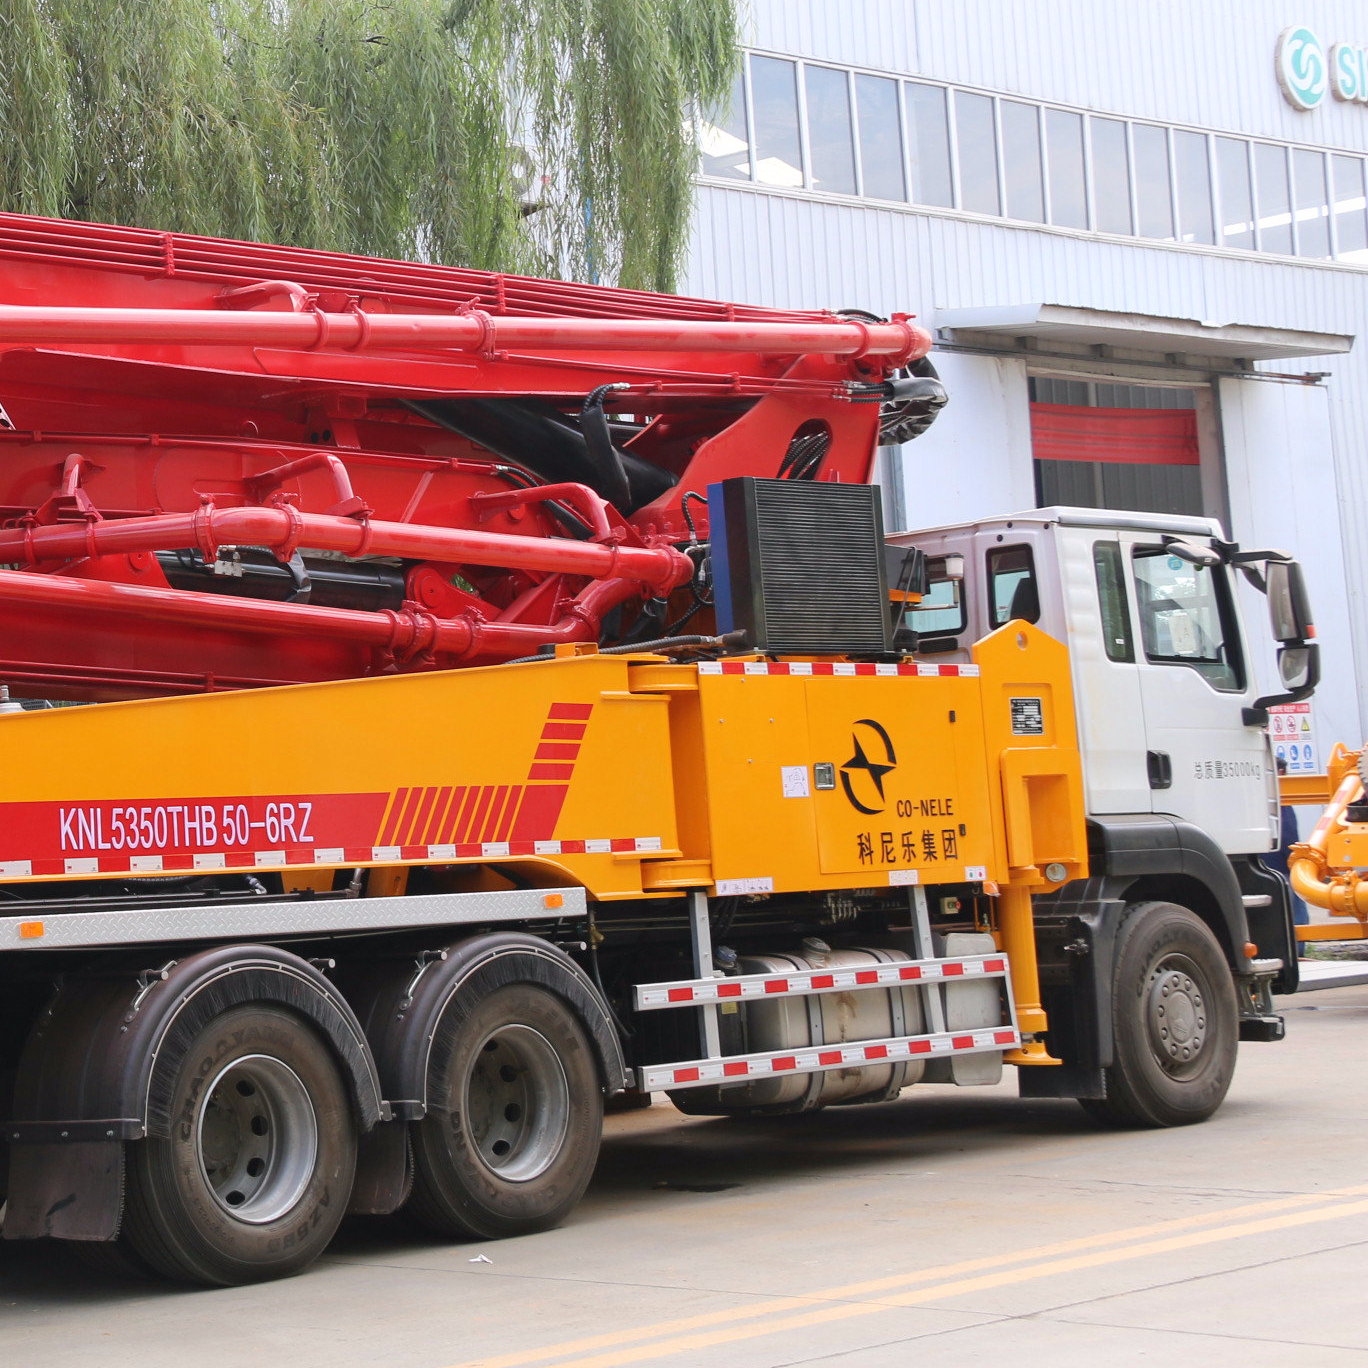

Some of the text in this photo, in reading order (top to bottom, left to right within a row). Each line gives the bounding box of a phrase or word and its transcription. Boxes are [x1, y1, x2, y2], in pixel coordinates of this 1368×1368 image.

[1338, 46, 1368, 98] SI
[59, 802, 314, 850] KNL5350THB 50-6RZ
[896, 798, 954, 818] CO-NELE
[857, 829, 958, 865] 科尼乐集团
